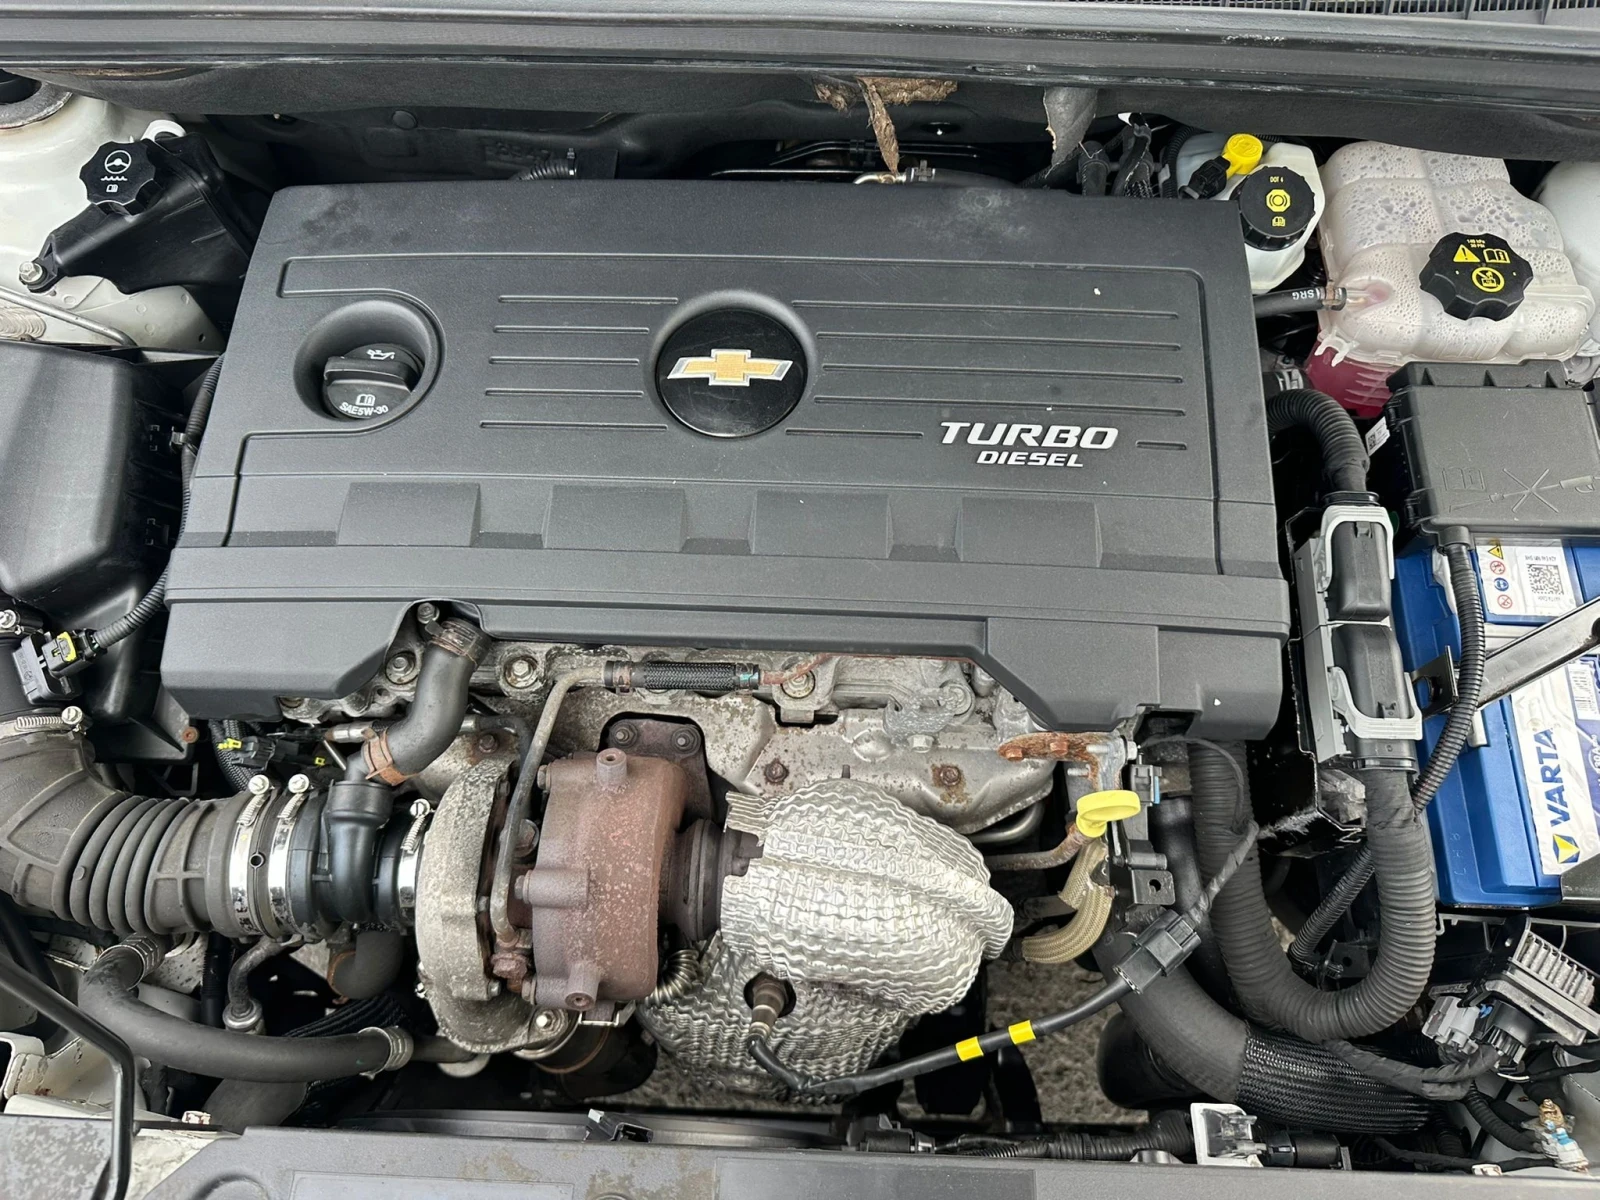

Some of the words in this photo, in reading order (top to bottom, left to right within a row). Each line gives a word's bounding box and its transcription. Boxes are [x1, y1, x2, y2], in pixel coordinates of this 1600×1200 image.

[1291, 289, 1315, 301] SRG
[339, 401, 389, 416] SAE5W-30
[940, 421, 1119, 450] TURBO
[976, 450, 1084, 468] DIESEL
[1533, 728, 1571, 828] VARTA
